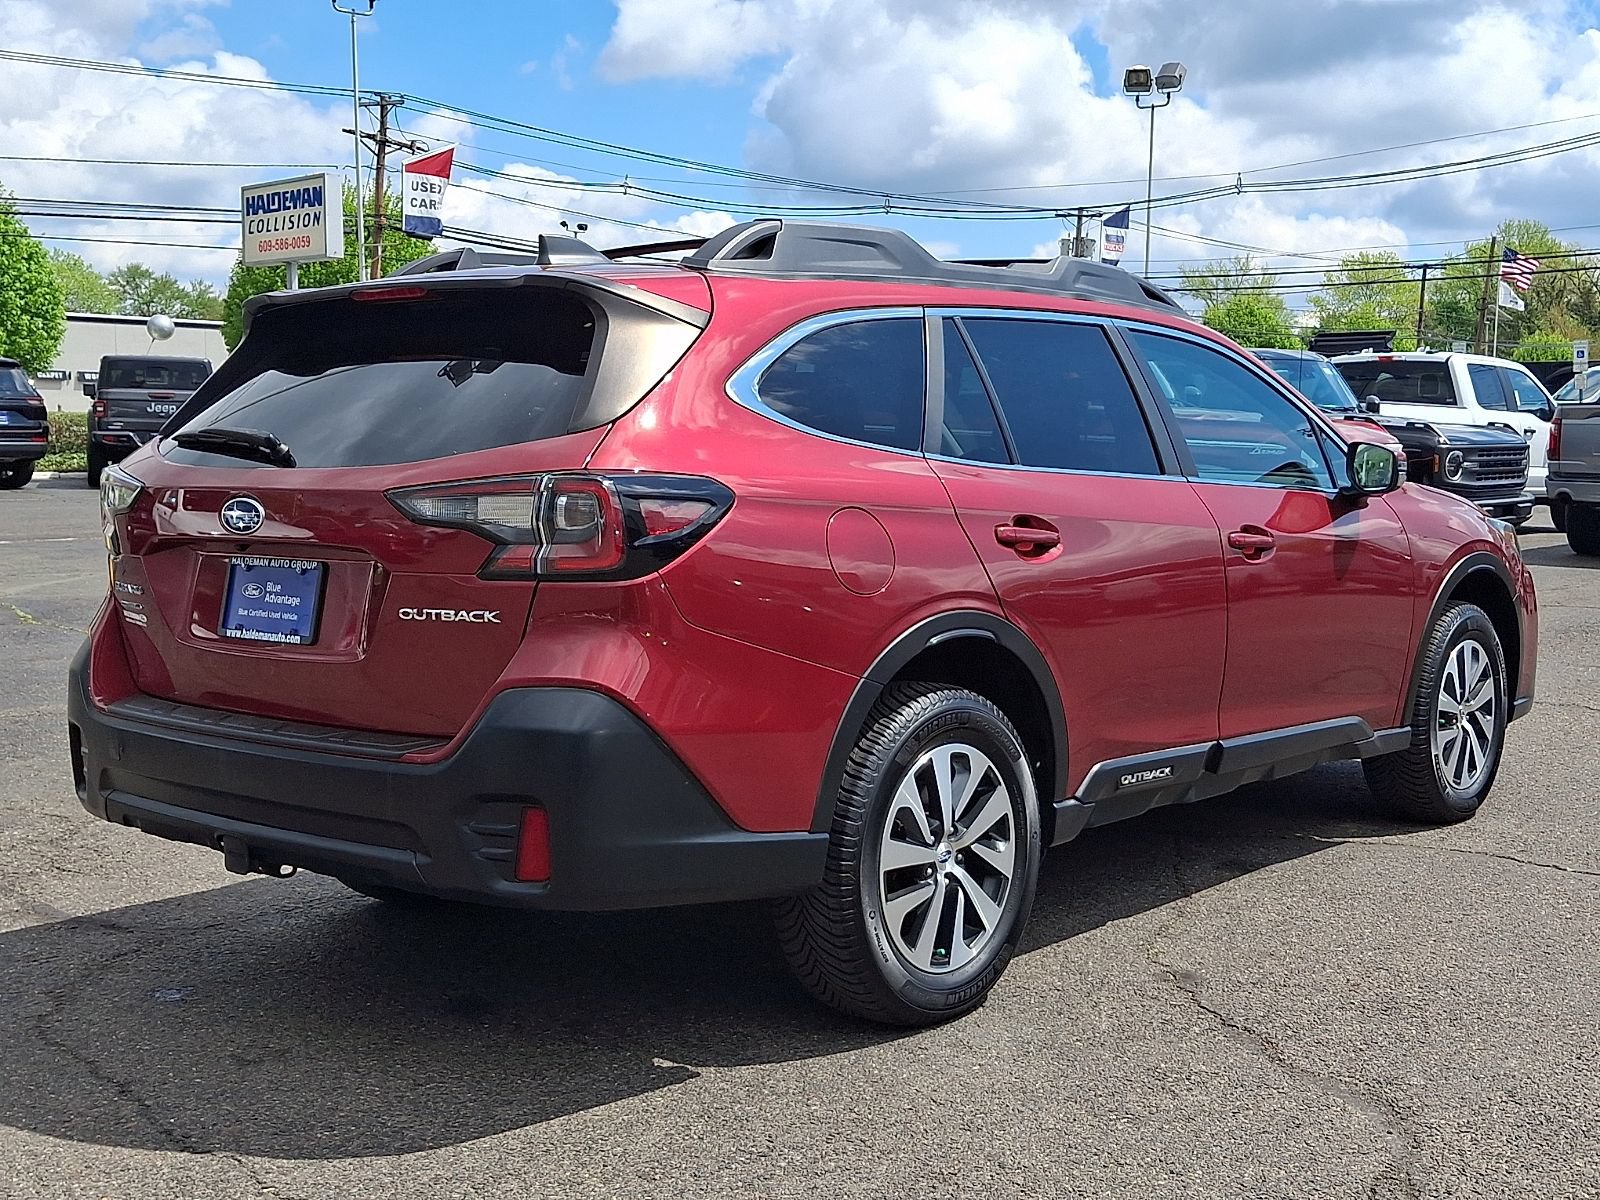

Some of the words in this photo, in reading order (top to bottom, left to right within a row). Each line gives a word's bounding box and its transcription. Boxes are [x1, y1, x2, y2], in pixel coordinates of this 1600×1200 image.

[245, 185, 323, 216] HALDEMAN
[248, 211, 321, 234] COLLISION
[258, 235, 311, 252] 609-586-0059
[146, 402, 177, 415] Jeep
[231, 557, 269, 568] HALDEMAN
[291, 561, 317, 572] GROUP
[245, 585, 261, 596] Ford
[266, 581, 281, 593] Blue
[264, 593, 301, 606] Advantage
[398, 607, 502, 623] OUTBACK
[226, 627, 301, 644] www.haldemanauto.com
[1121, 766, 1172, 785] OUTBACK
